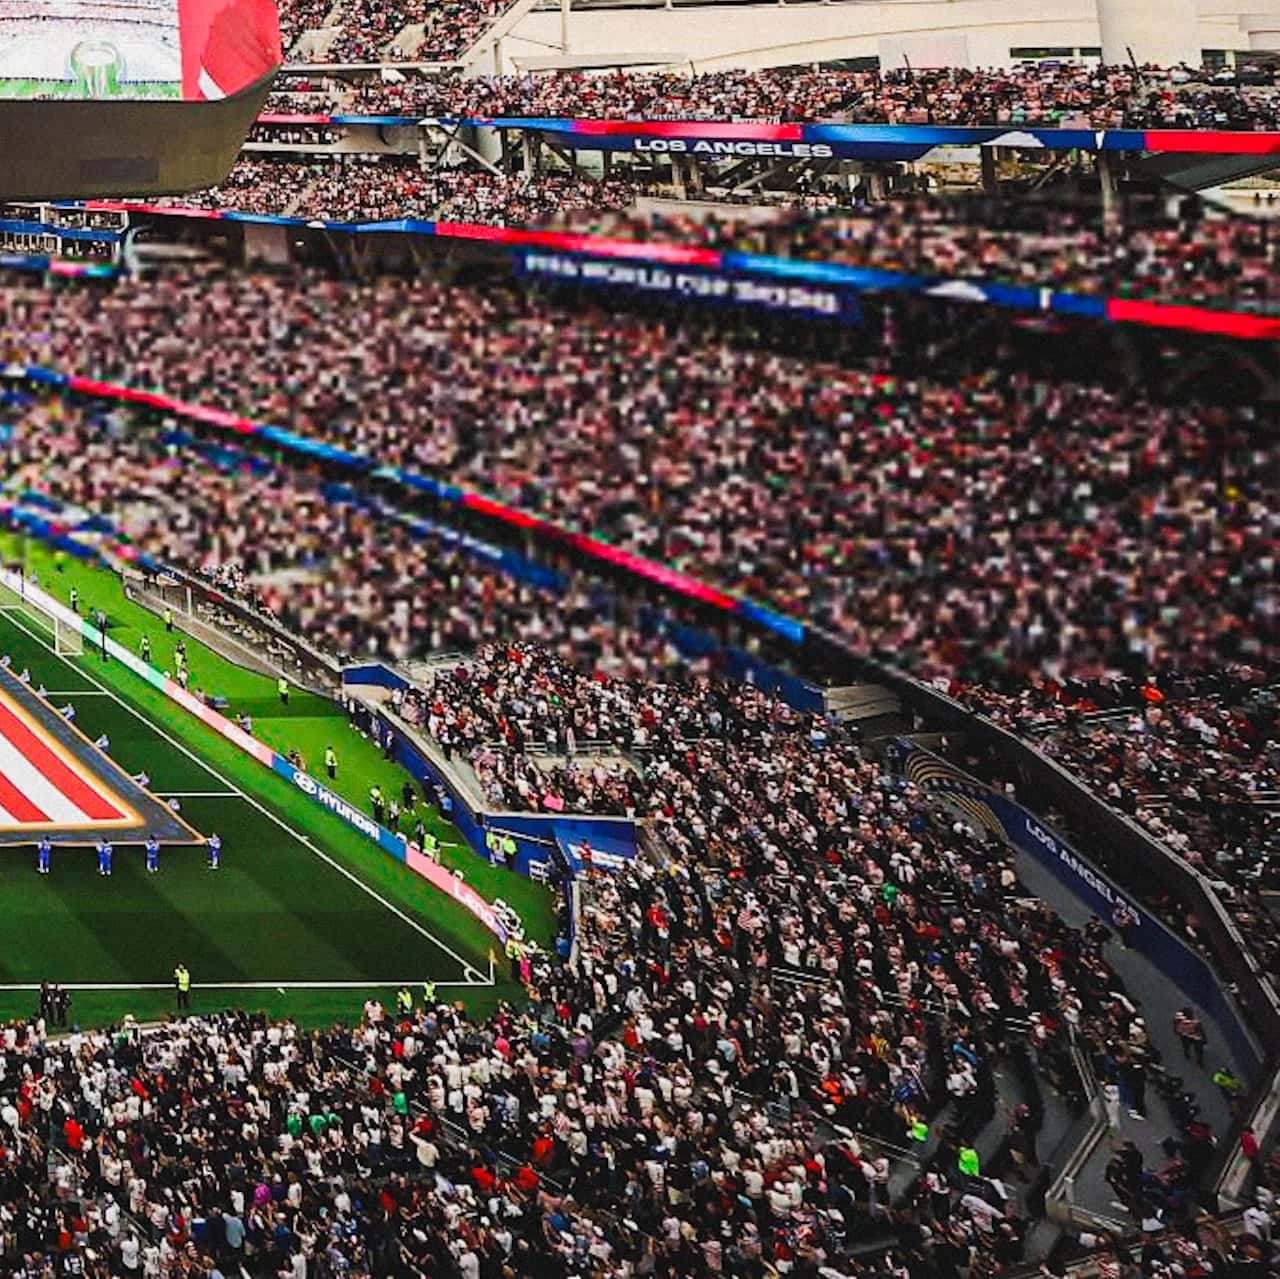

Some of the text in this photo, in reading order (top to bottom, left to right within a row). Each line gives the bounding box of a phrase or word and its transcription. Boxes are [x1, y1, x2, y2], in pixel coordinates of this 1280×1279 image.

[634, 138, 834, 158] LOS ANGELES
[317, 786, 380, 841] HYUNDAI
[1025, 818, 1057, 854] LOS
